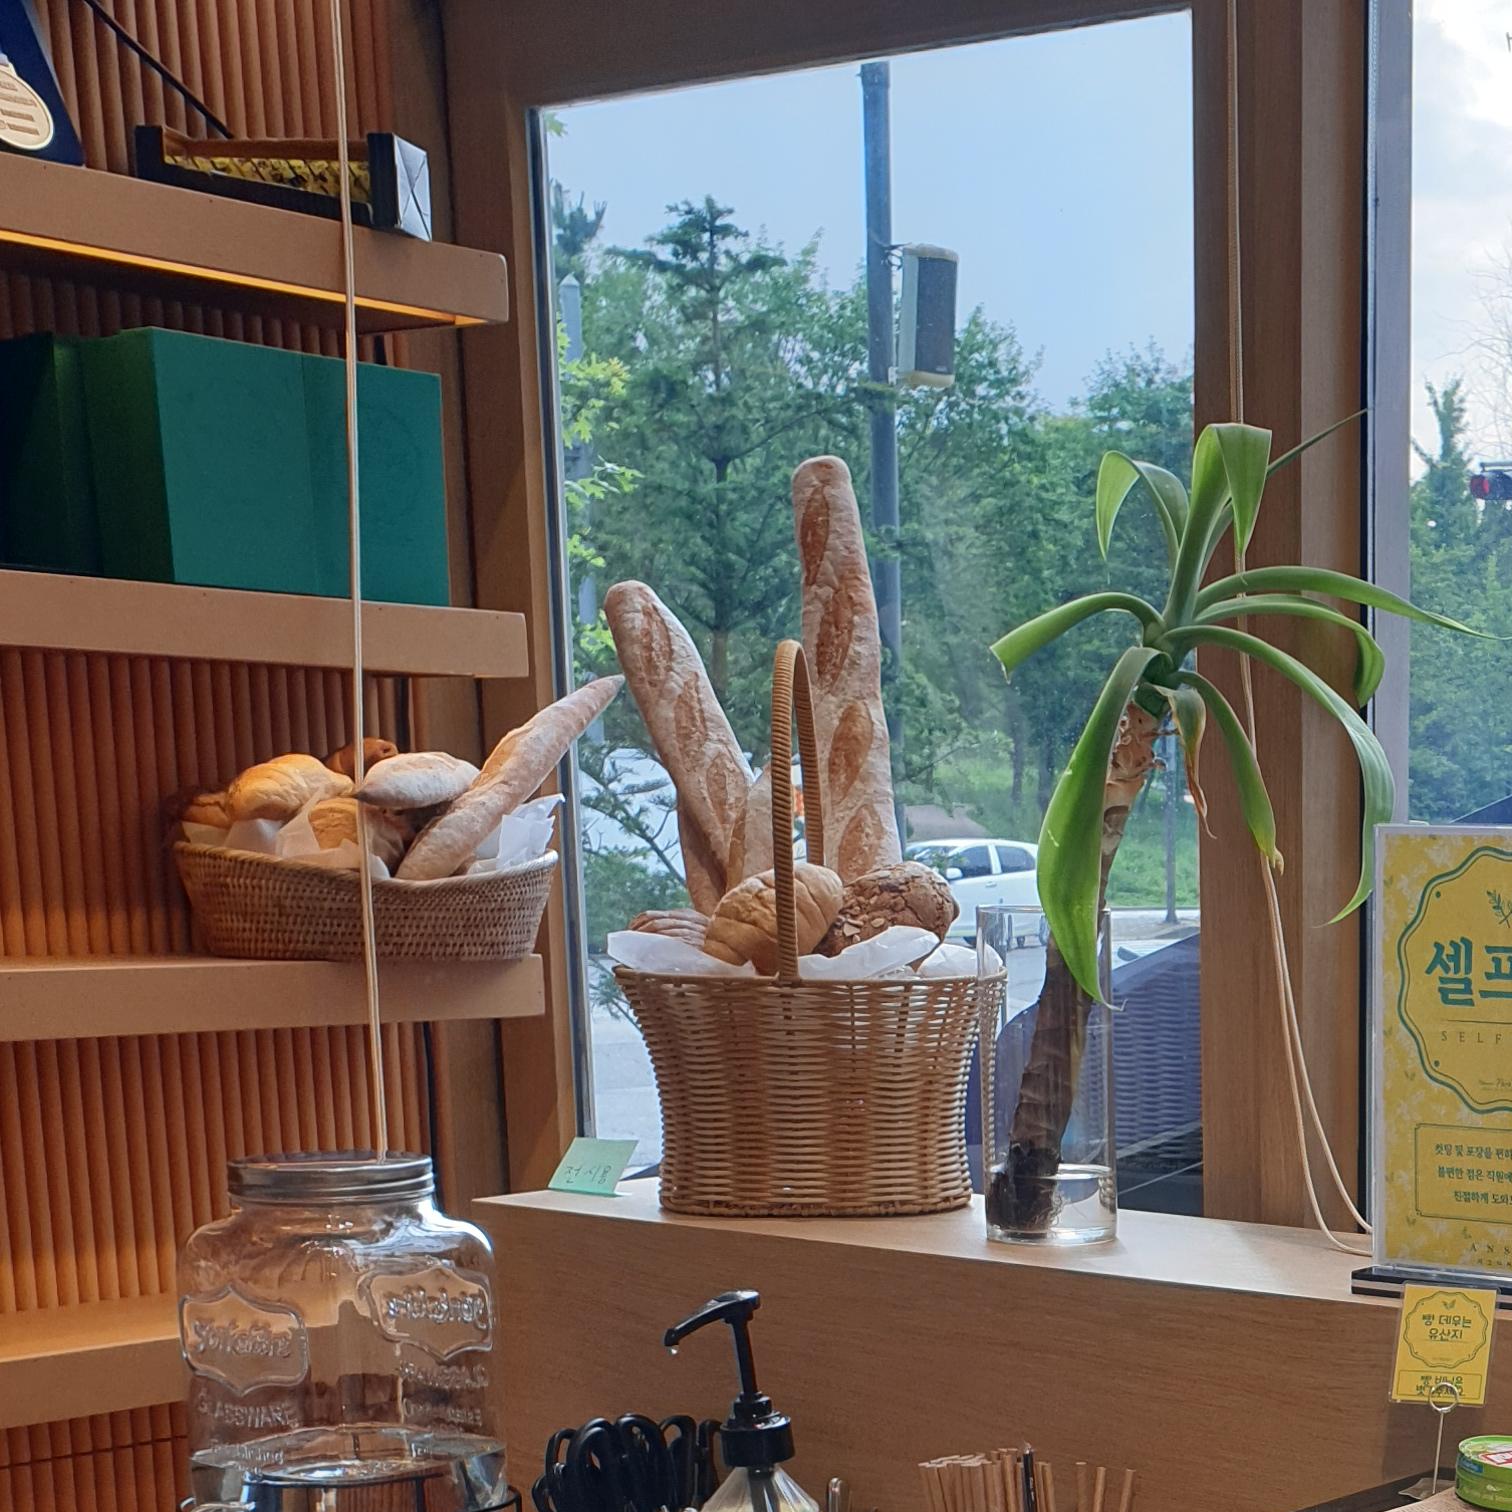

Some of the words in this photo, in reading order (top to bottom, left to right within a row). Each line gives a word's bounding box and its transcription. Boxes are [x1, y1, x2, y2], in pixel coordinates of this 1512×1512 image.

[1466, 1145, 1492, 1160] 포장을
[1438, 1166, 1463, 1179] 불편한
[1467, 1168, 1484, 1182] 점은
[1454, 1190, 1489, 1204] 친절하게
[1439, 1315, 1472, 1328] 데우는
[1428, 1328, 1463, 1342] 유산지
